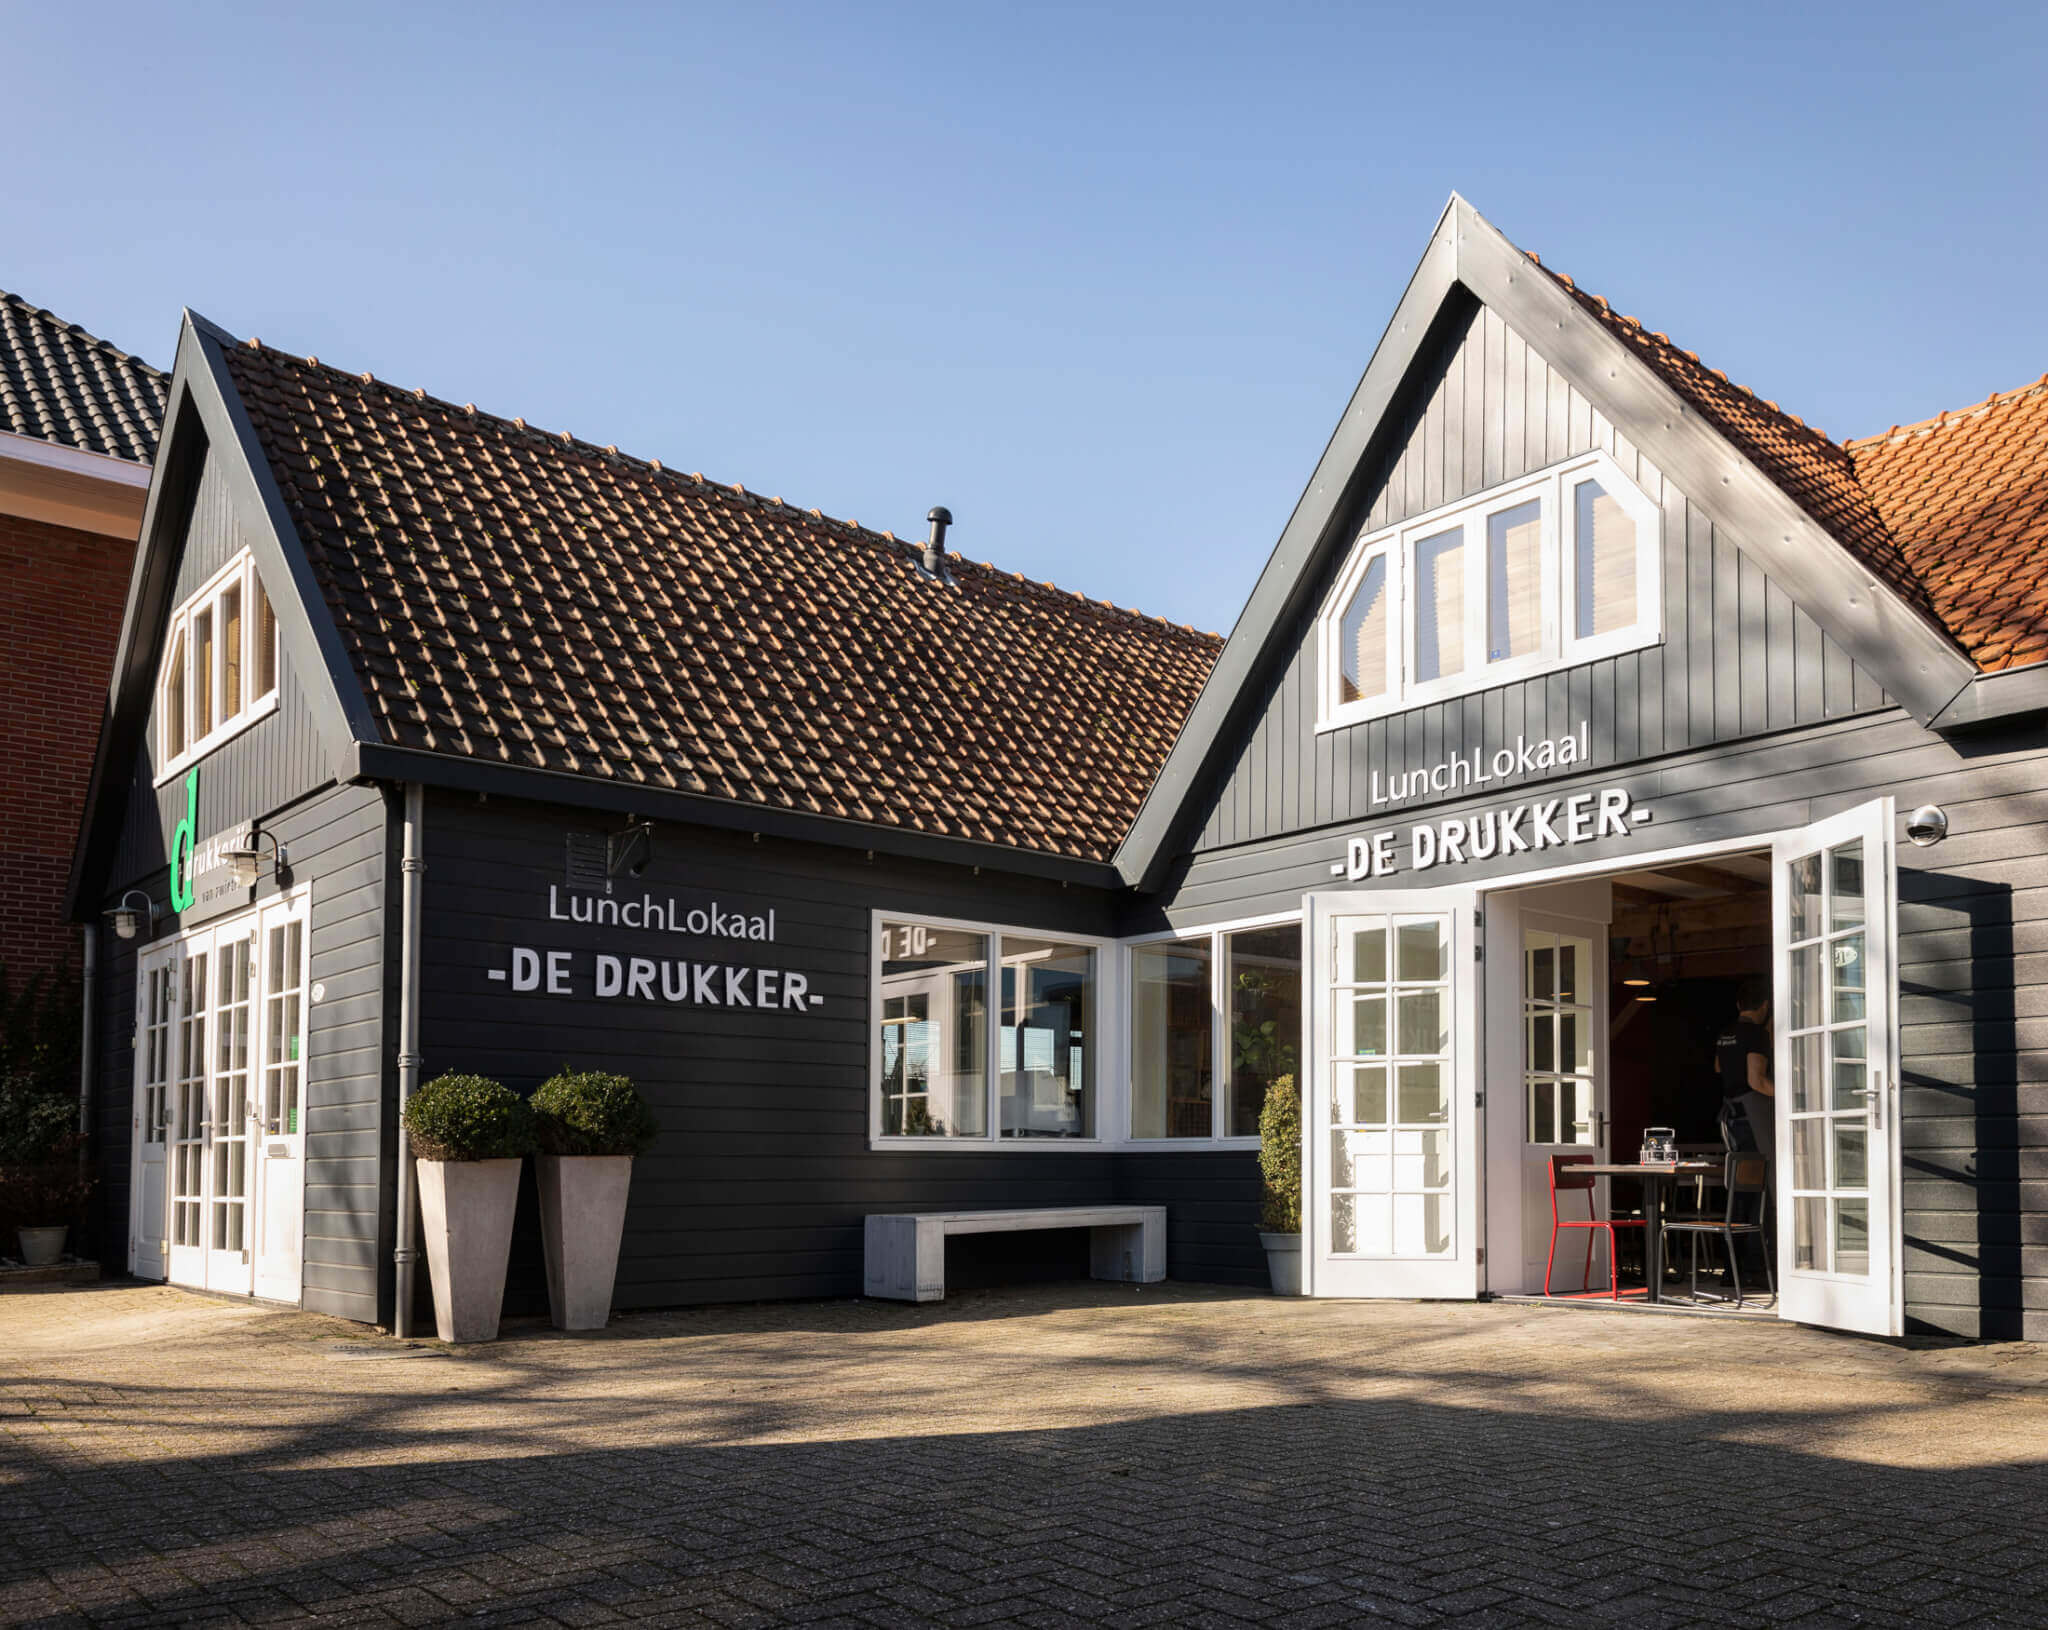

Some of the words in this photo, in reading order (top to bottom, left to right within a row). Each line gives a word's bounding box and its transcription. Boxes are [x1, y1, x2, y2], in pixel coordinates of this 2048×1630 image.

[1371, 720, 1588, 805] LunchLokaal
[1330, 831, 1395, 882] -DE
[1412, 787, 1650, 870] DRUKKER-
[550, 885, 775, 942] LunchLokaal
[487, 947, 573, 994] -DE
[595, 954, 824, 1012] DRUKKER-
